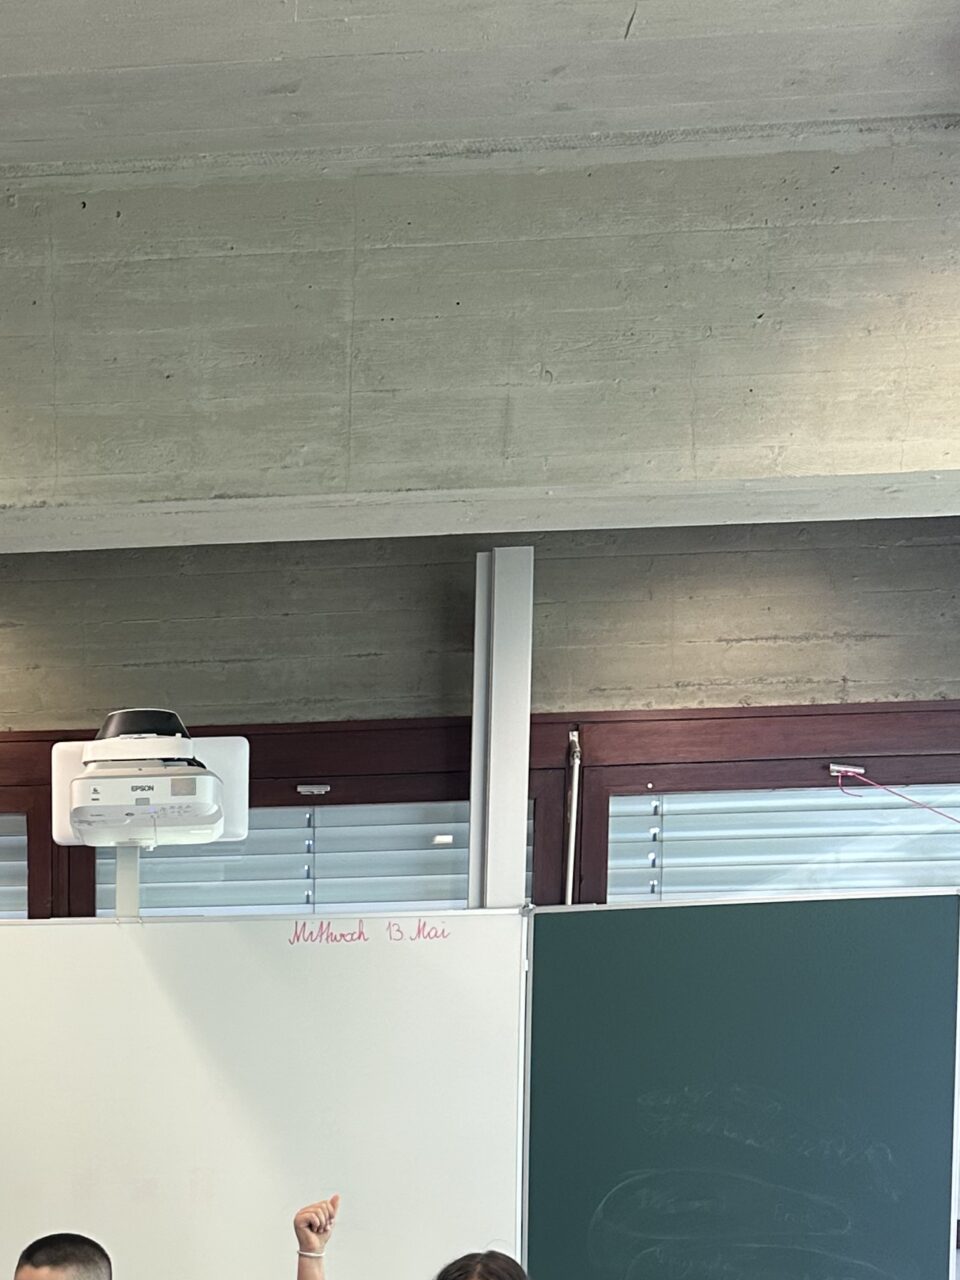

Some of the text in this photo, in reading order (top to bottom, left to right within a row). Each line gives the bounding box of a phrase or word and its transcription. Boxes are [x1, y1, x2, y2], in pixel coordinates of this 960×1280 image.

[130, 784, 154, 792] EPSON
[288, 919, 369, 945] Mittwoch
[410, 918, 451, 941] Mai
